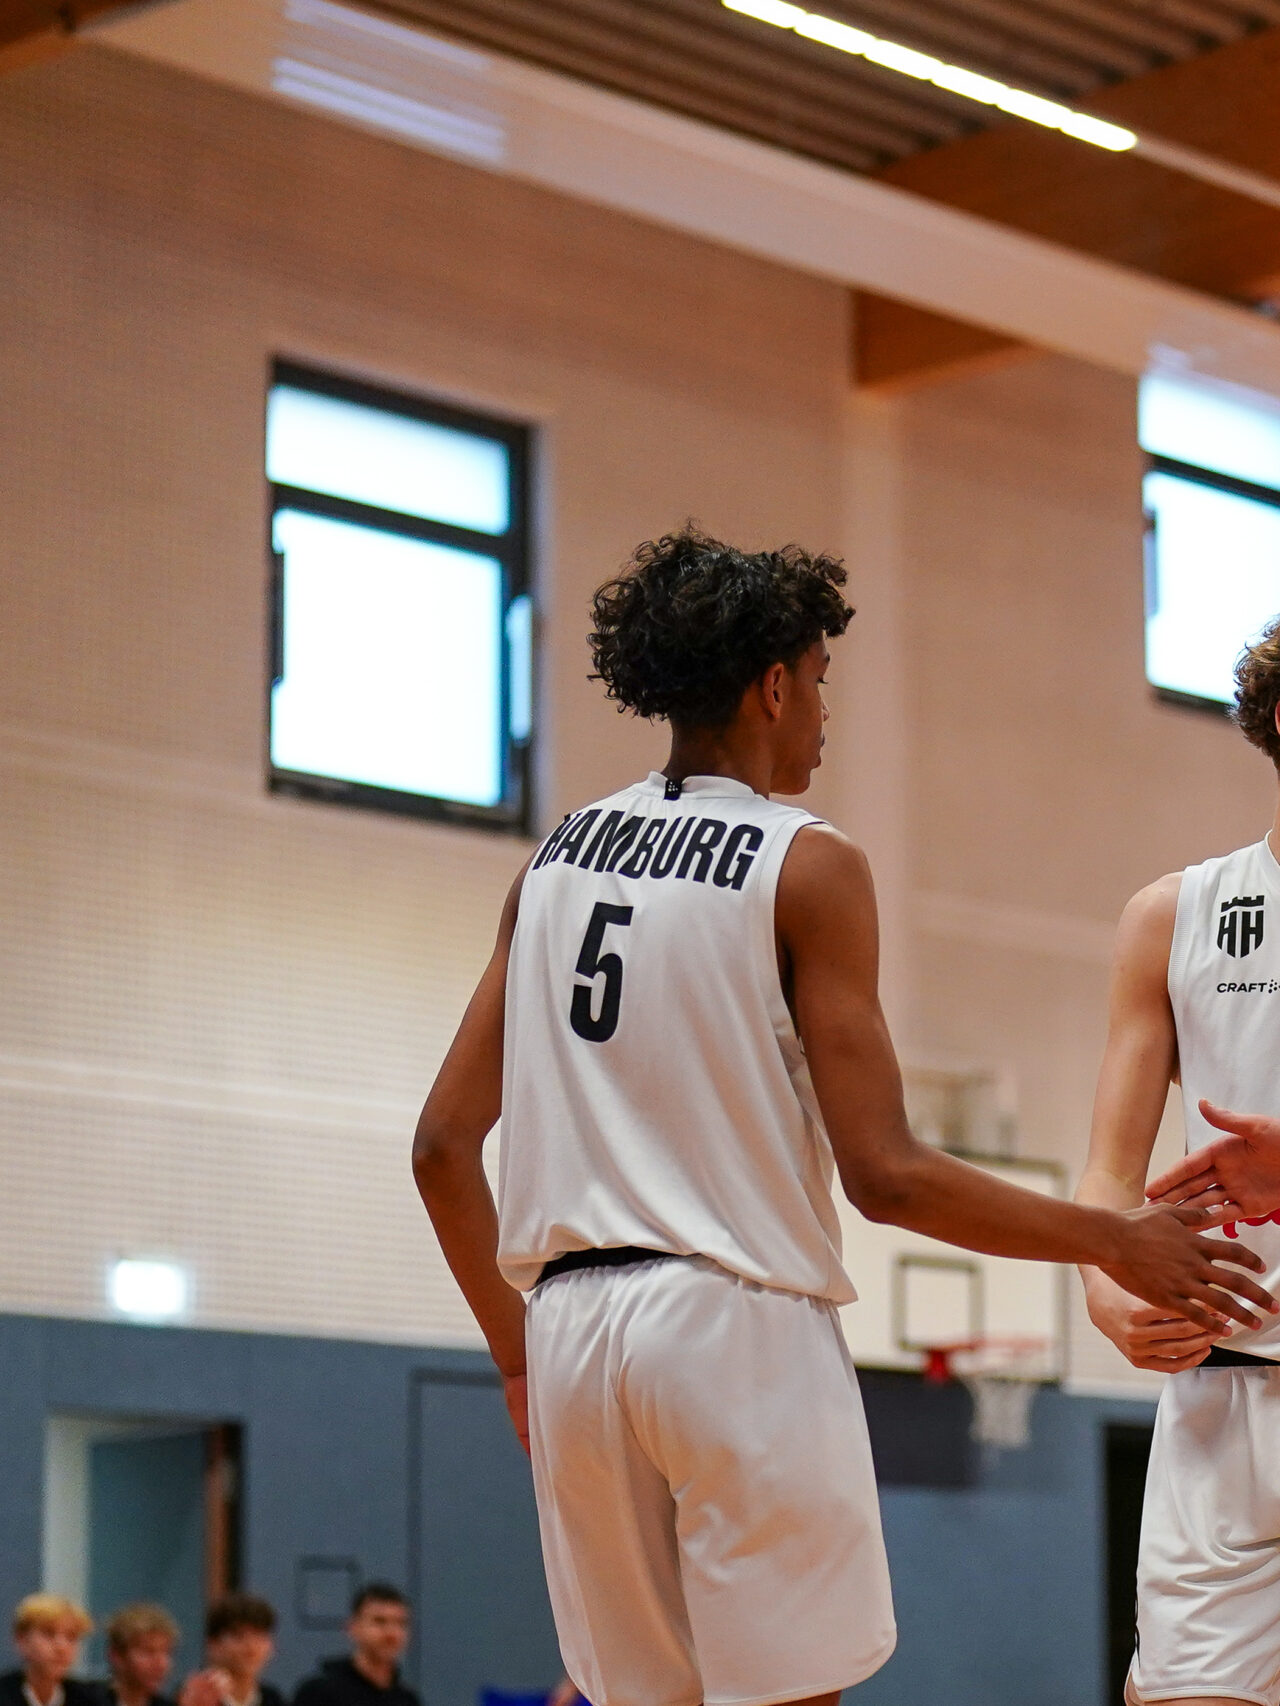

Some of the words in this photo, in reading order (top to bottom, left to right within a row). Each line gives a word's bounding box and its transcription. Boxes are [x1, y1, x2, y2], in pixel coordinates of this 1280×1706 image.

[532, 808, 764, 892] HAMBURG
[569, 901, 634, 1043] 5
[1216, 981, 1268, 994] CRAFT
